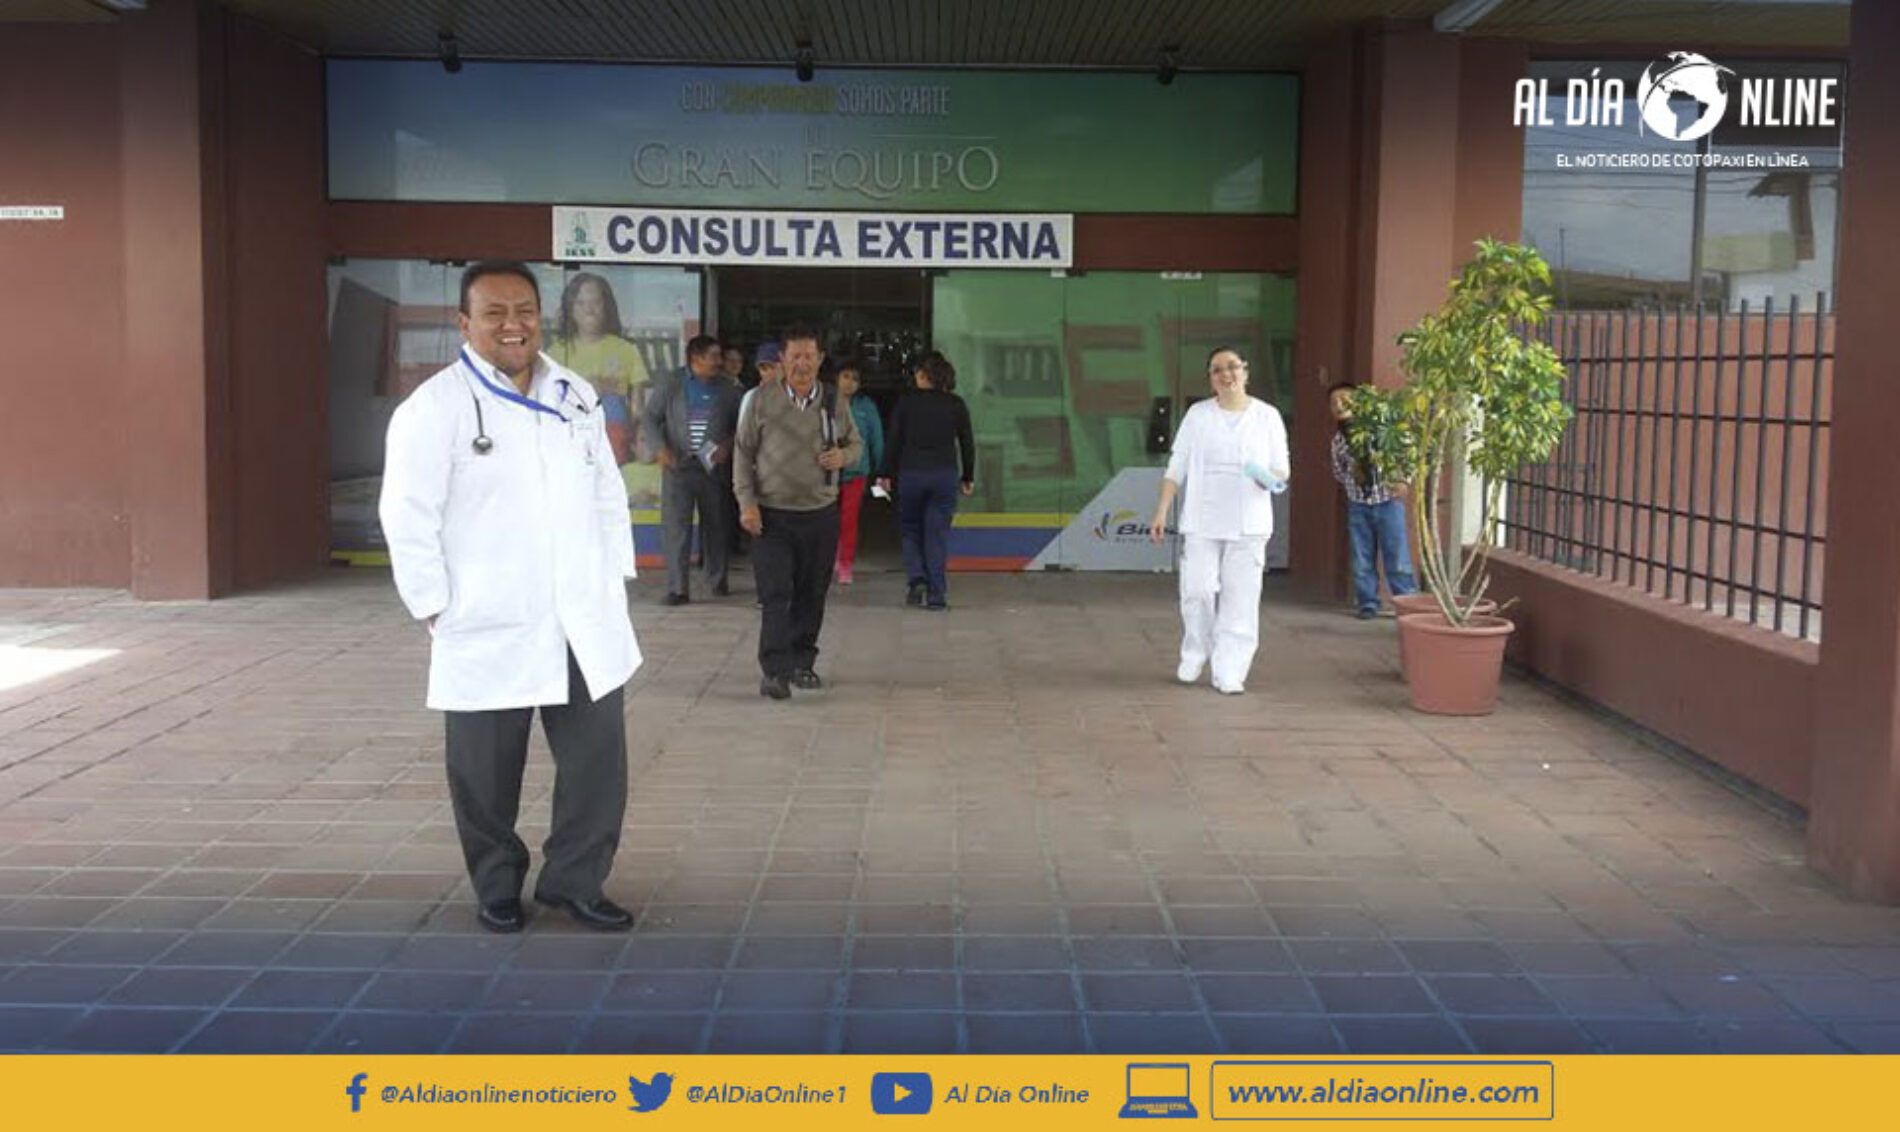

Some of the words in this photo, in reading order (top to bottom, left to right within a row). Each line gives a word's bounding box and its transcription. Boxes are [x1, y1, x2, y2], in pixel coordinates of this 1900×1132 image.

[837, 83, 897, 116] SOMOS
[901, 85, 951, 116] PARTE
[632, 142, 782, 190] GRAN
[803, 145, 999, 200] EQUIPO
[607, 215, 843, 258] CONSULTA
[857, 220, 1061, 261] EXTERNA
